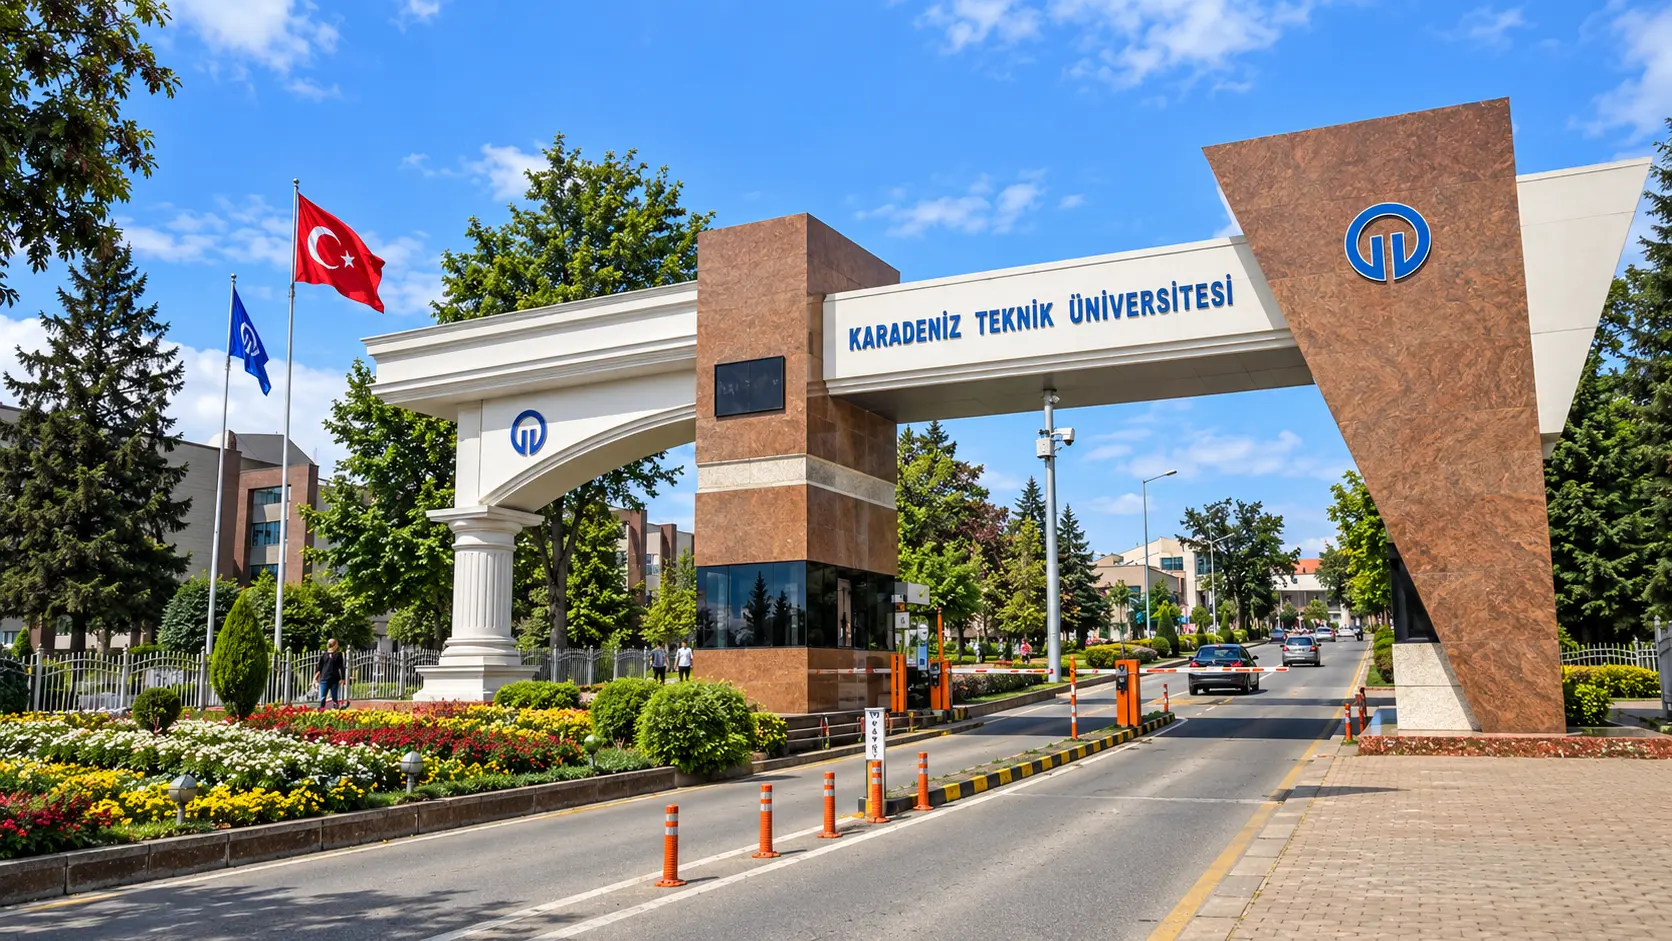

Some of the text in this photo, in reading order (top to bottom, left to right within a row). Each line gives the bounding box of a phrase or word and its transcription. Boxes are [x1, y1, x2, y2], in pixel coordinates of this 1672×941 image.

[849, 274, 1233, 351] KARADENİZ TEKNİK ÜNİVERSİTESİ
